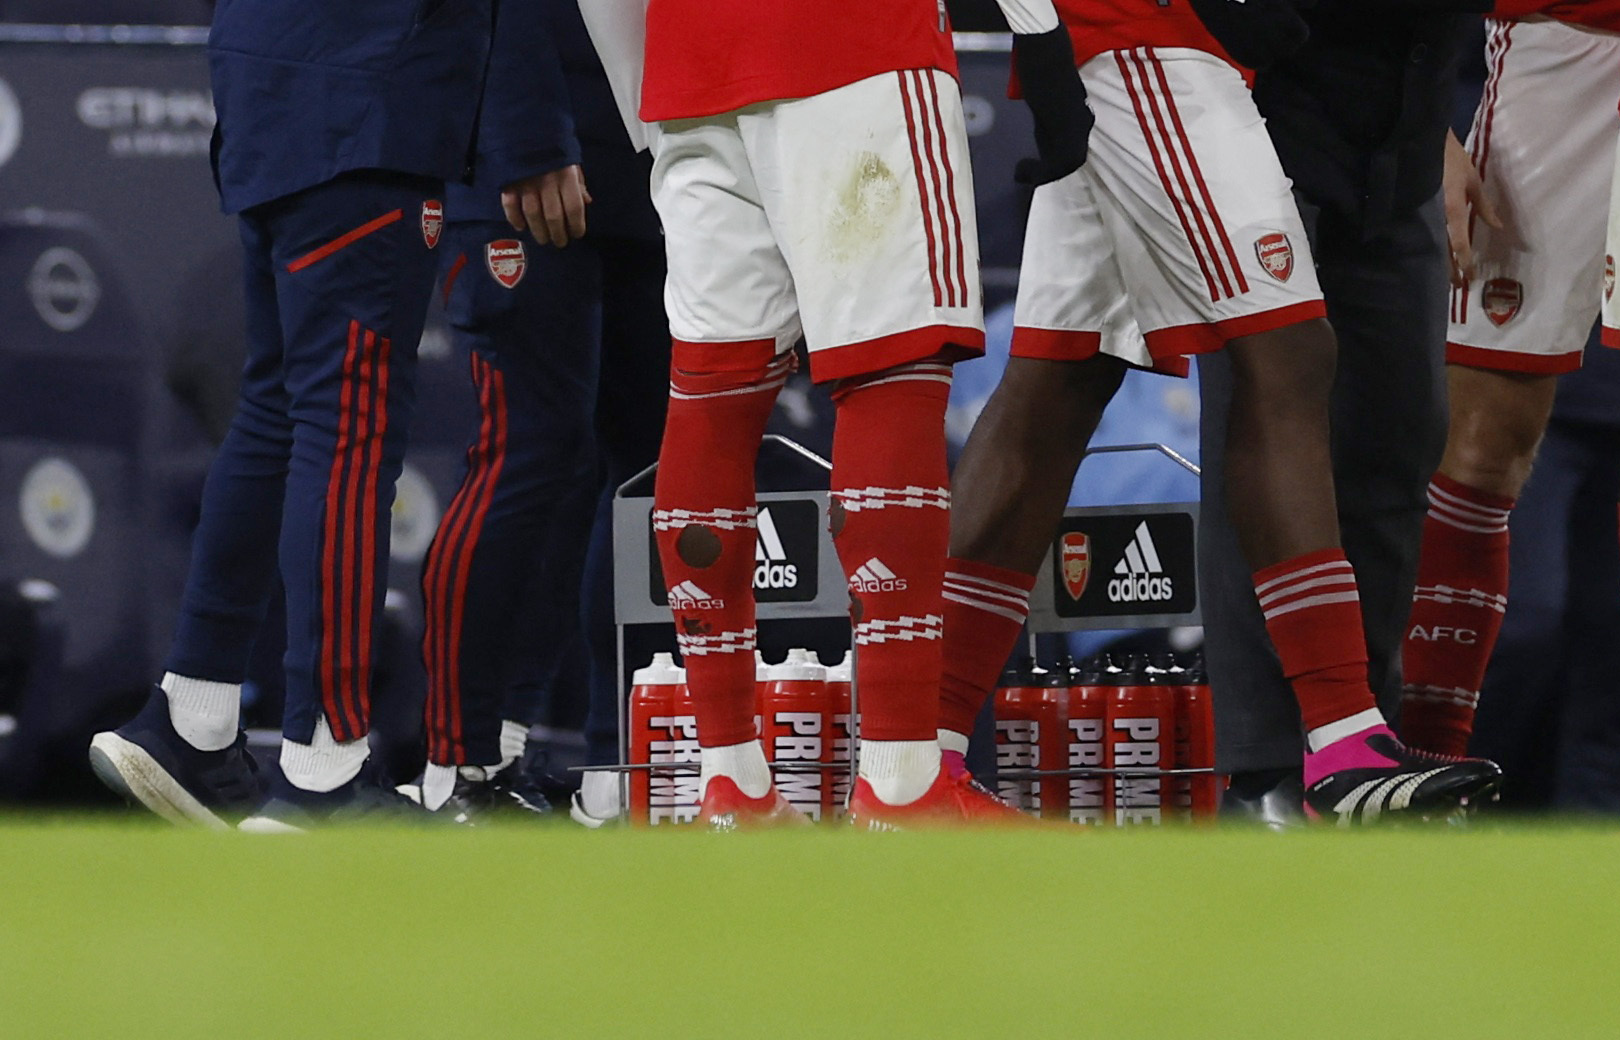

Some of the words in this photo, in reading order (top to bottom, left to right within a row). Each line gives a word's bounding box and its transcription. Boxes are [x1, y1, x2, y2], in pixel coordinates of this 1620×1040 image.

[1107, 571, 1173, 602] adidas
[1408, 624, 1478, 644] AFC
[1114, 718, 1161, 827] PRIME
